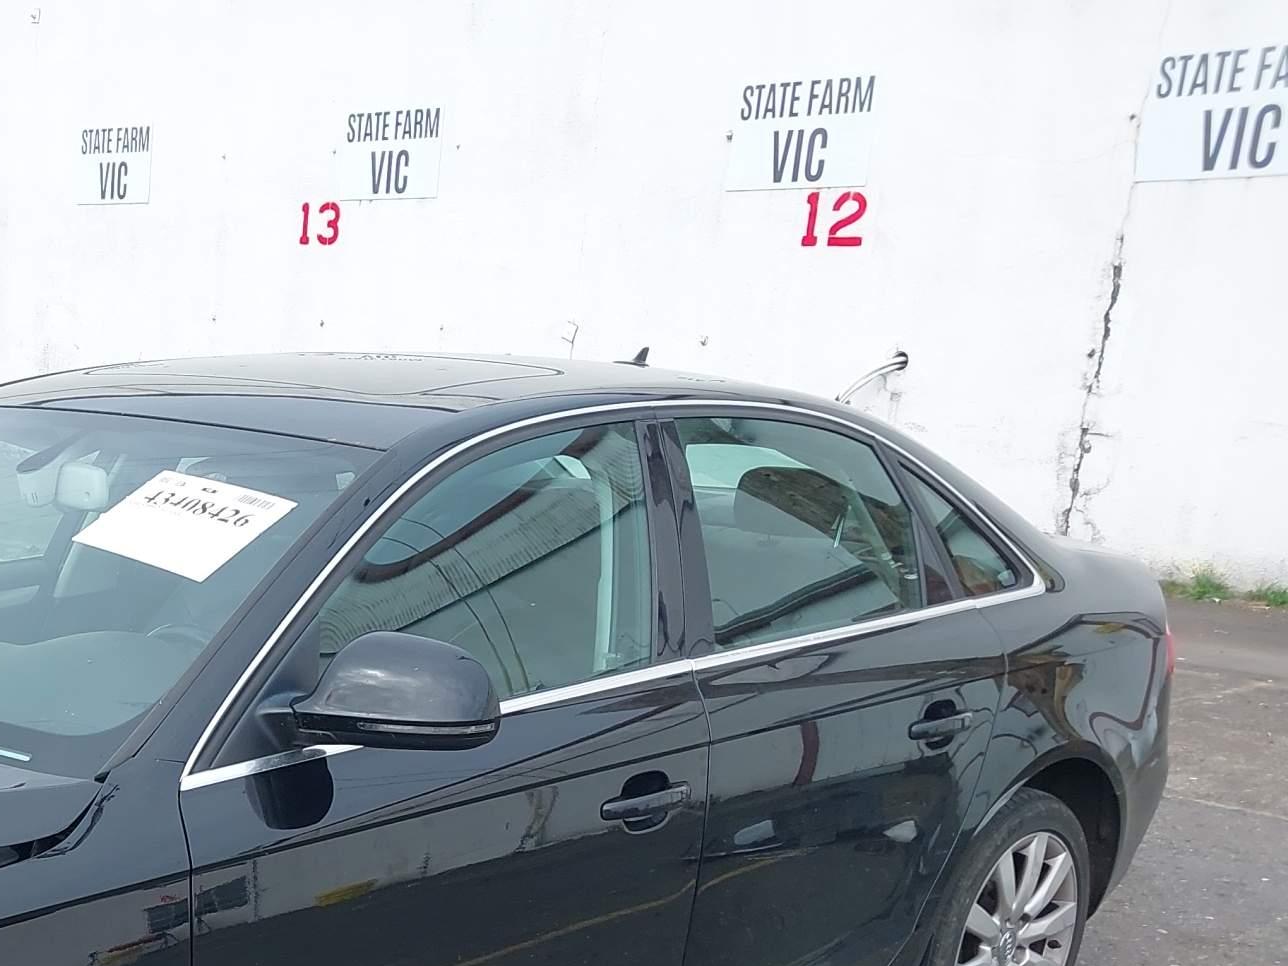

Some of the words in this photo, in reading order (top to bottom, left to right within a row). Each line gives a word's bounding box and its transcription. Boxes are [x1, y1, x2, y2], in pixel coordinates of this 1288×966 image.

[1156, 48, 1250, 99] STATE
[740, 80, 802, 121] STATE
[807, 75, 876, 117] FARM
[81, 127, 113, 155] STATE
[115, 125, 150, 153] FARM
[346, 111, 391, 143] STATE
[394, 107, 440, 140] FARM
[1202, 103, 1282, 172] VIC
[370, 149, 410, 195] VIC
[772, 127, 828, 184] VIC
[99, 160, 128, 200] VIC
[298, 201, 341, 246] 13
[800, 191, 868, 247] 12
